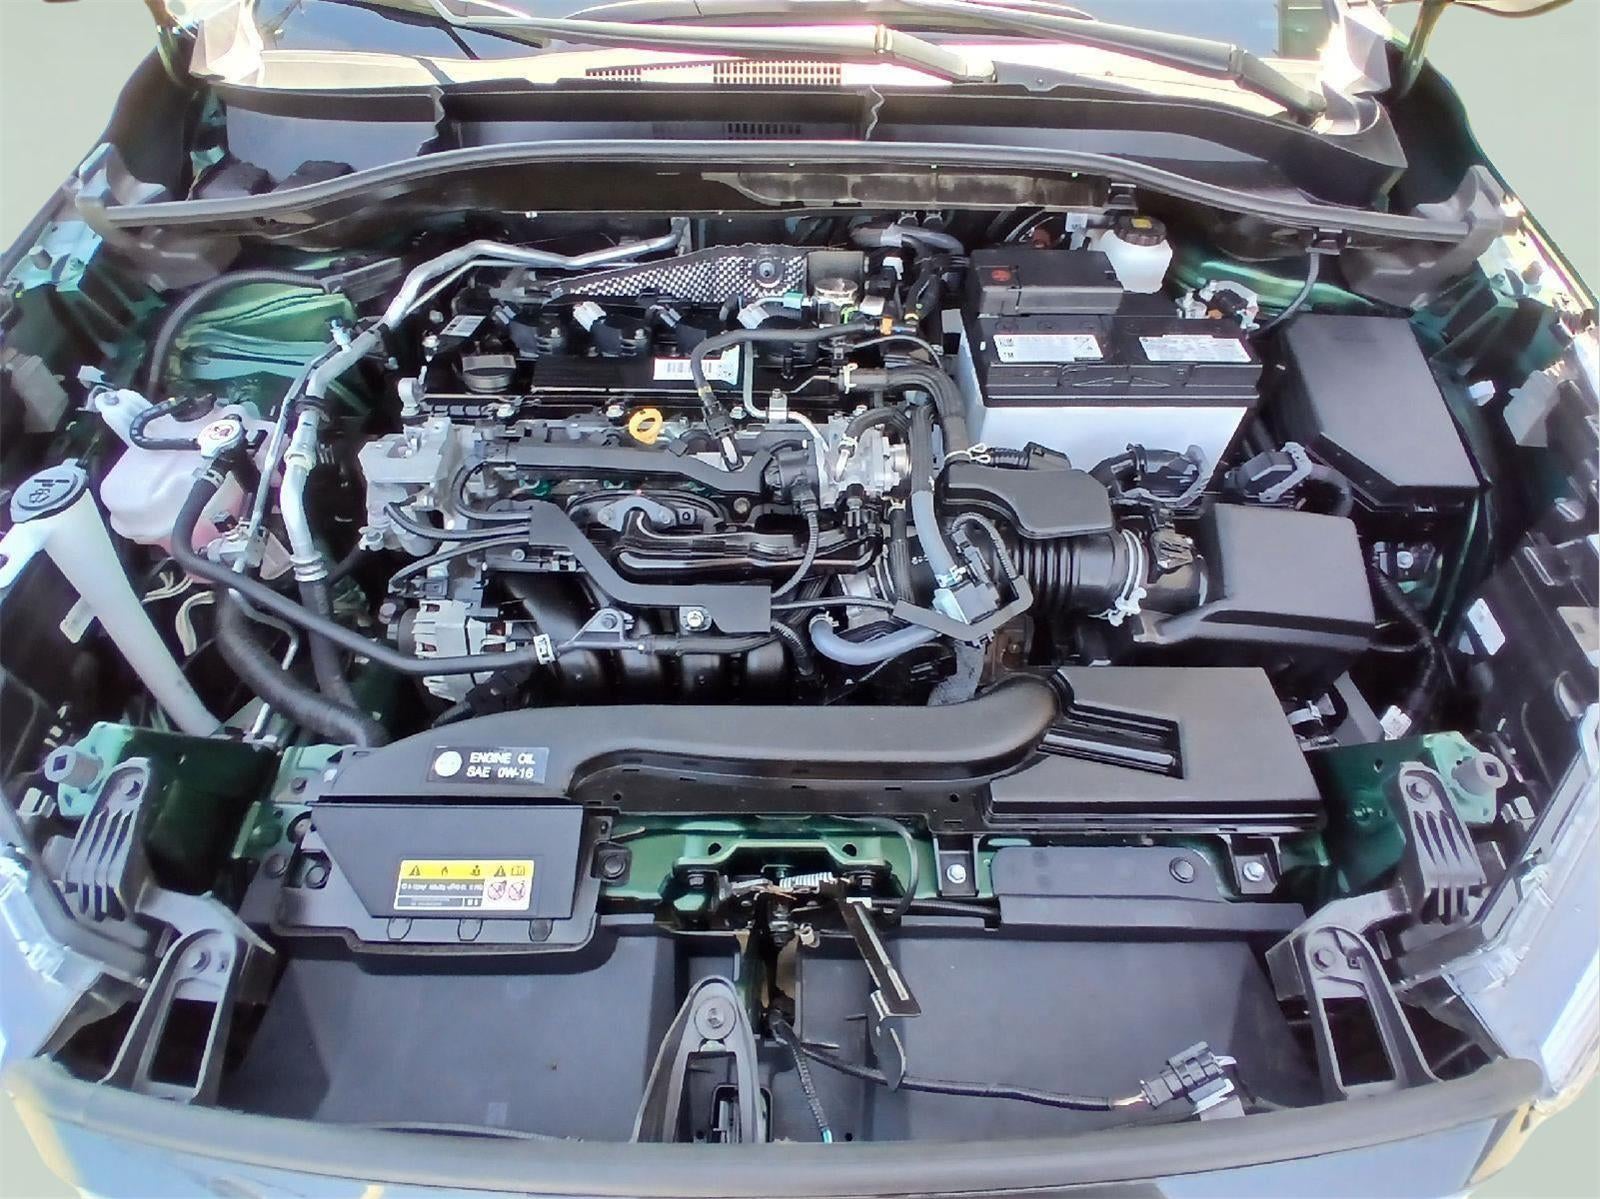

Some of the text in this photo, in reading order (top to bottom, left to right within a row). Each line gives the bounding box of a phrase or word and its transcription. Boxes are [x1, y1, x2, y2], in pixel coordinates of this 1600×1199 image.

[469, 752, 535, 764] ENGINE OIL
[466, 767, 534, 779] SAE 0W-16
